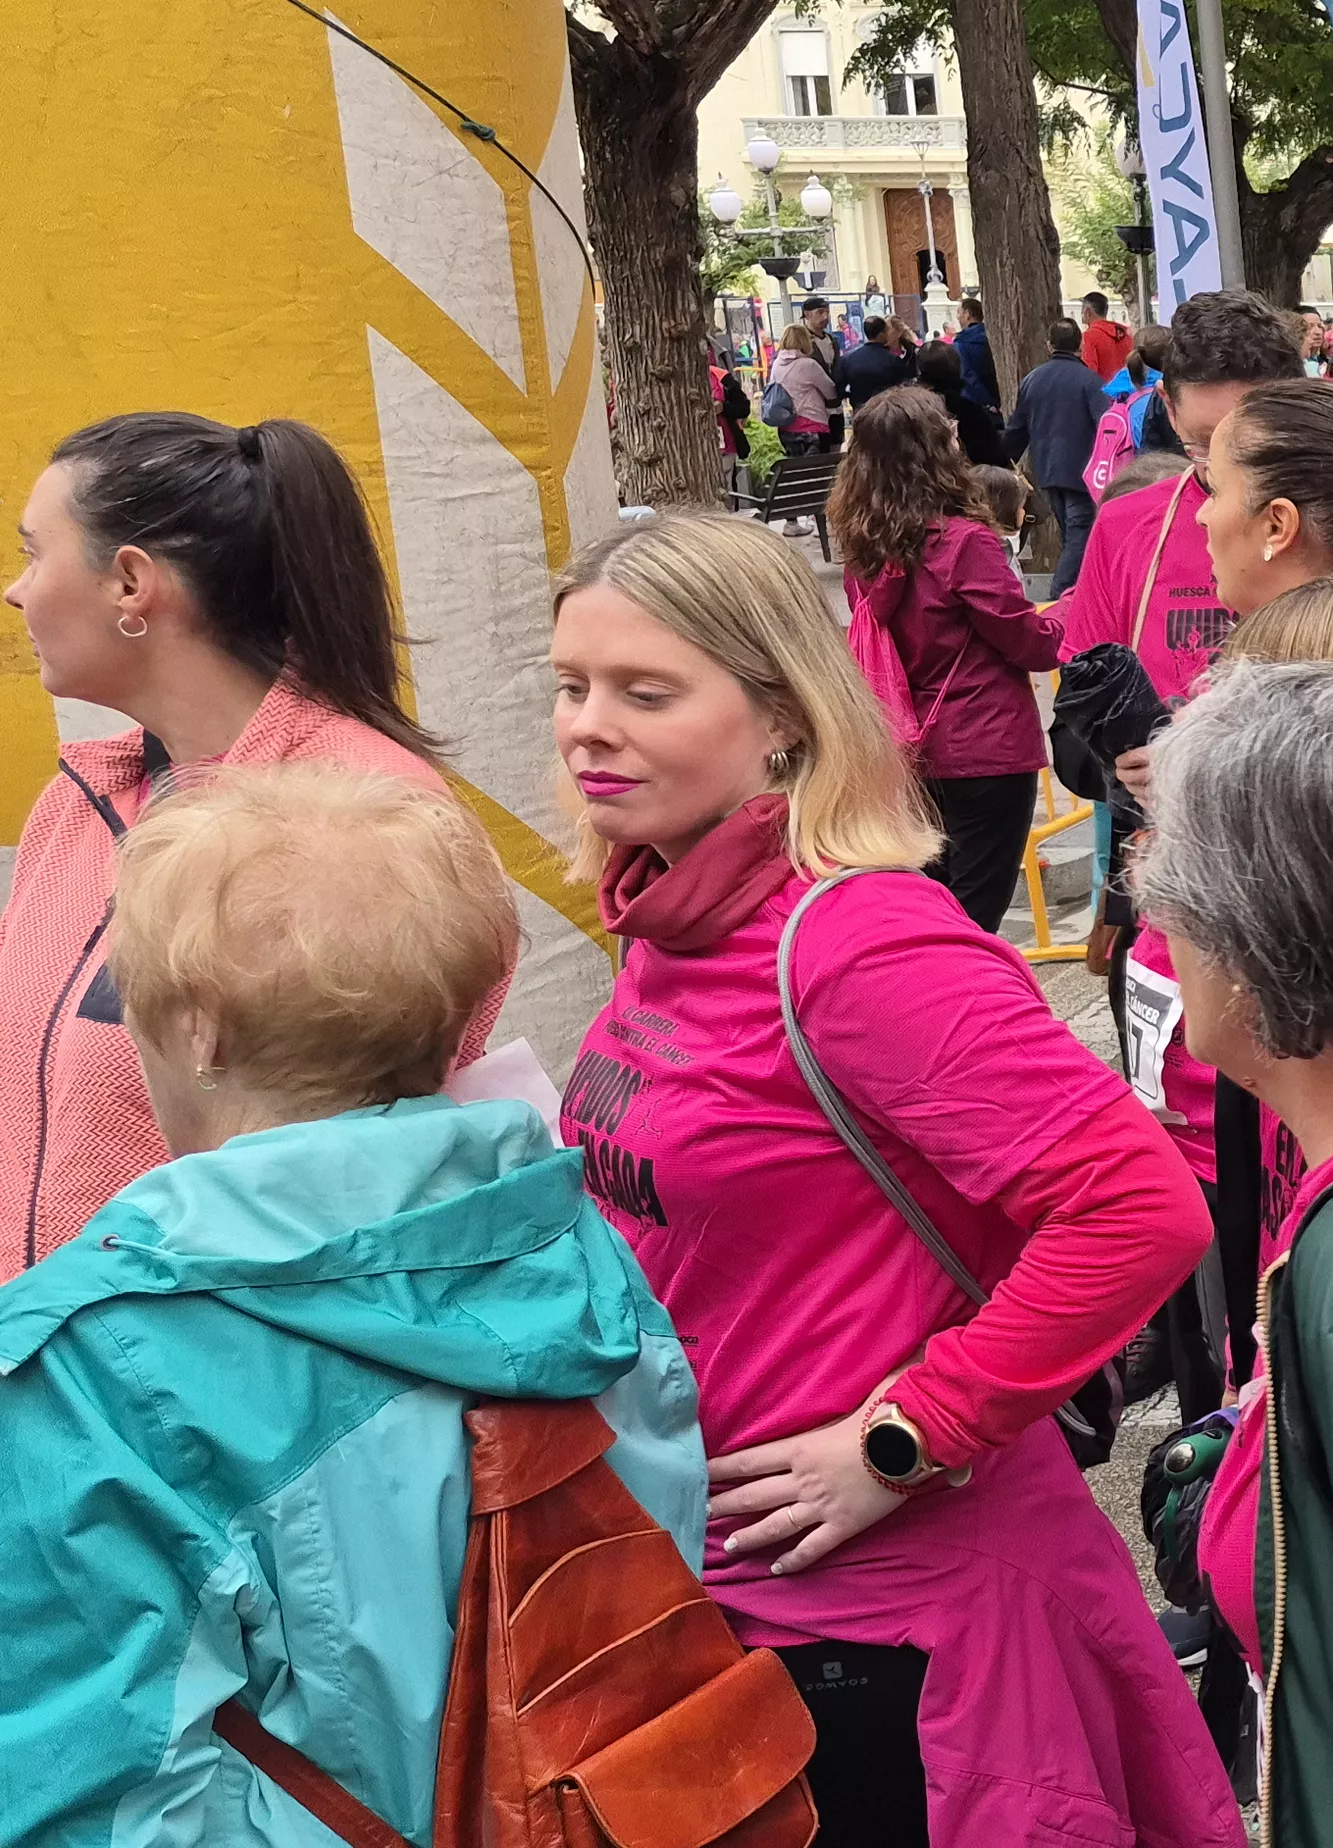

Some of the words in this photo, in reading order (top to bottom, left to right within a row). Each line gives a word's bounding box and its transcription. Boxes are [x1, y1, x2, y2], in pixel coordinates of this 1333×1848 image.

[1169, 586, 1211, 598] HUESCA
[631, 1009, 681, 1038] CARRERA
[1130, 996, 1160, 1025] CÁNCER
